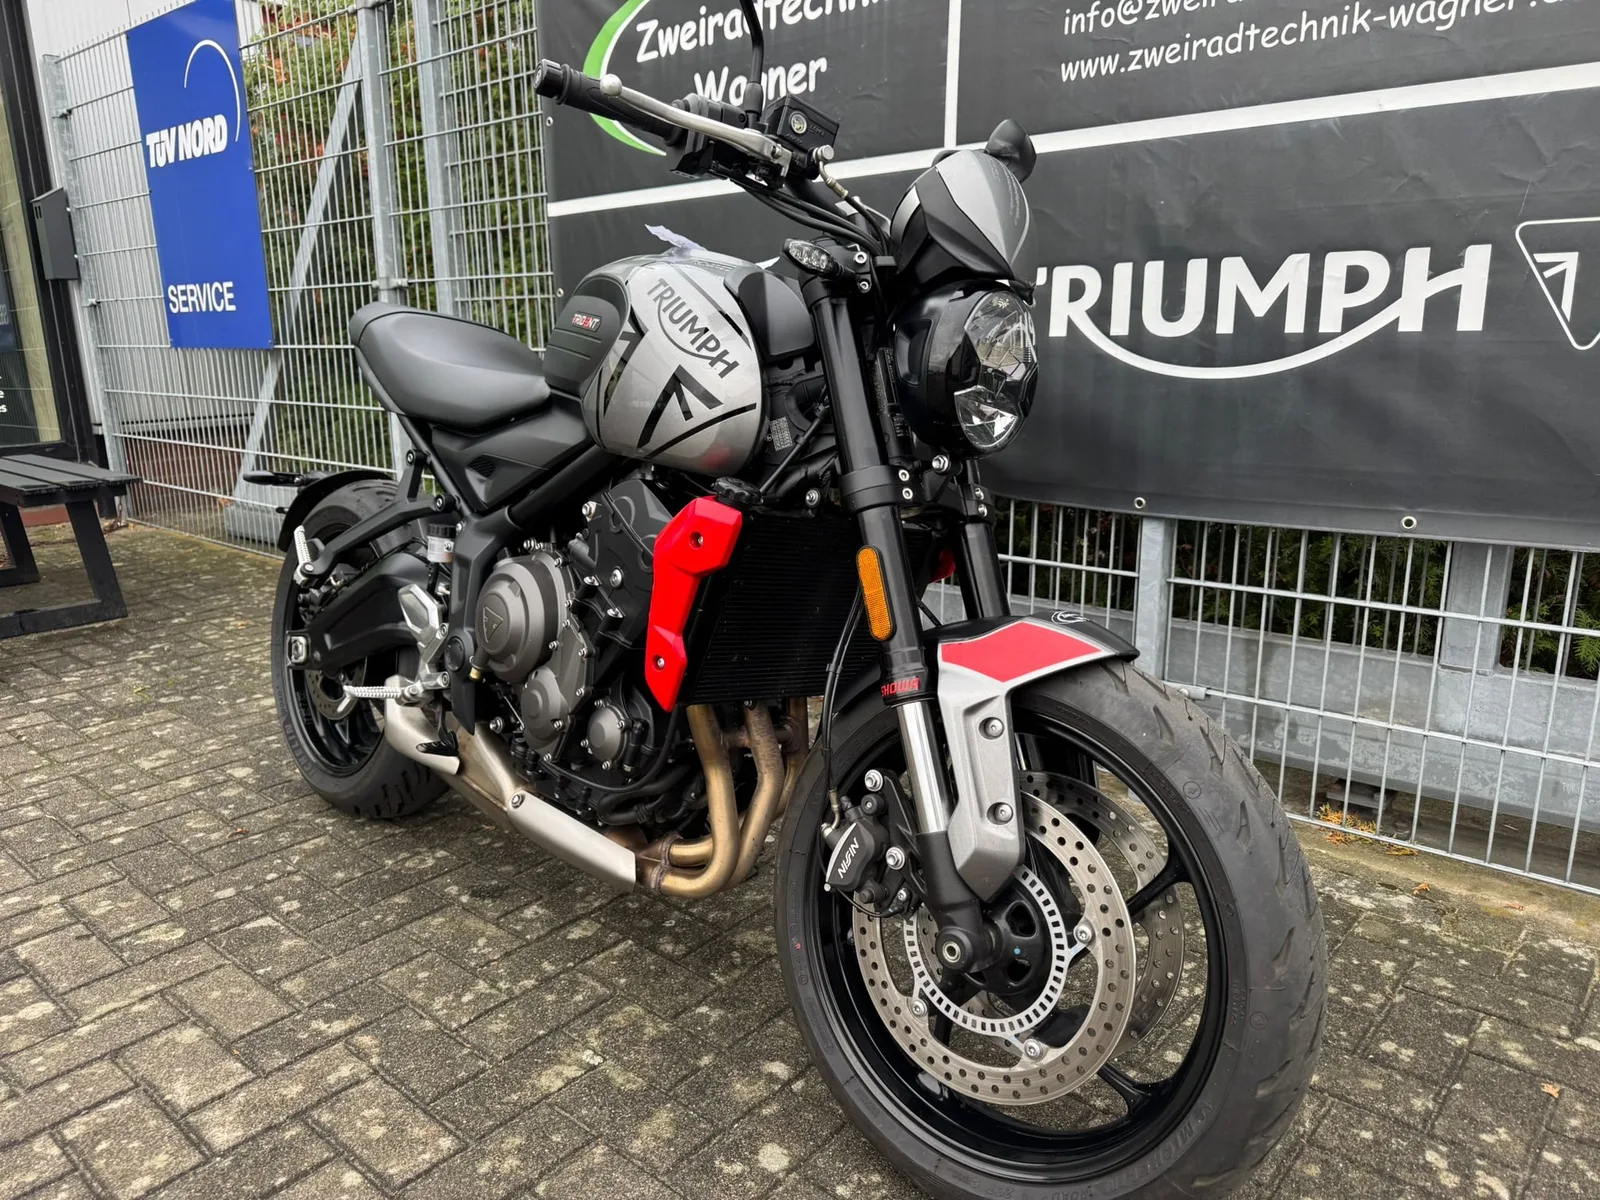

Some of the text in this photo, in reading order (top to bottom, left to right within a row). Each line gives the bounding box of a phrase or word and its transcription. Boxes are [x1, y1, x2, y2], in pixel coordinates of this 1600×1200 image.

[694, 57, 828, 110] Waner
[177, 113, 228, 161] NORD
[167, 281, 237, 313] SERVICE
[1035, 243, 1493, 379] RIUMPH
[646, 278, 740, 379] TRIUMPH
[880, 676, 920, 697] SHOWA
[837, 836, 860, 879] NISSIN
